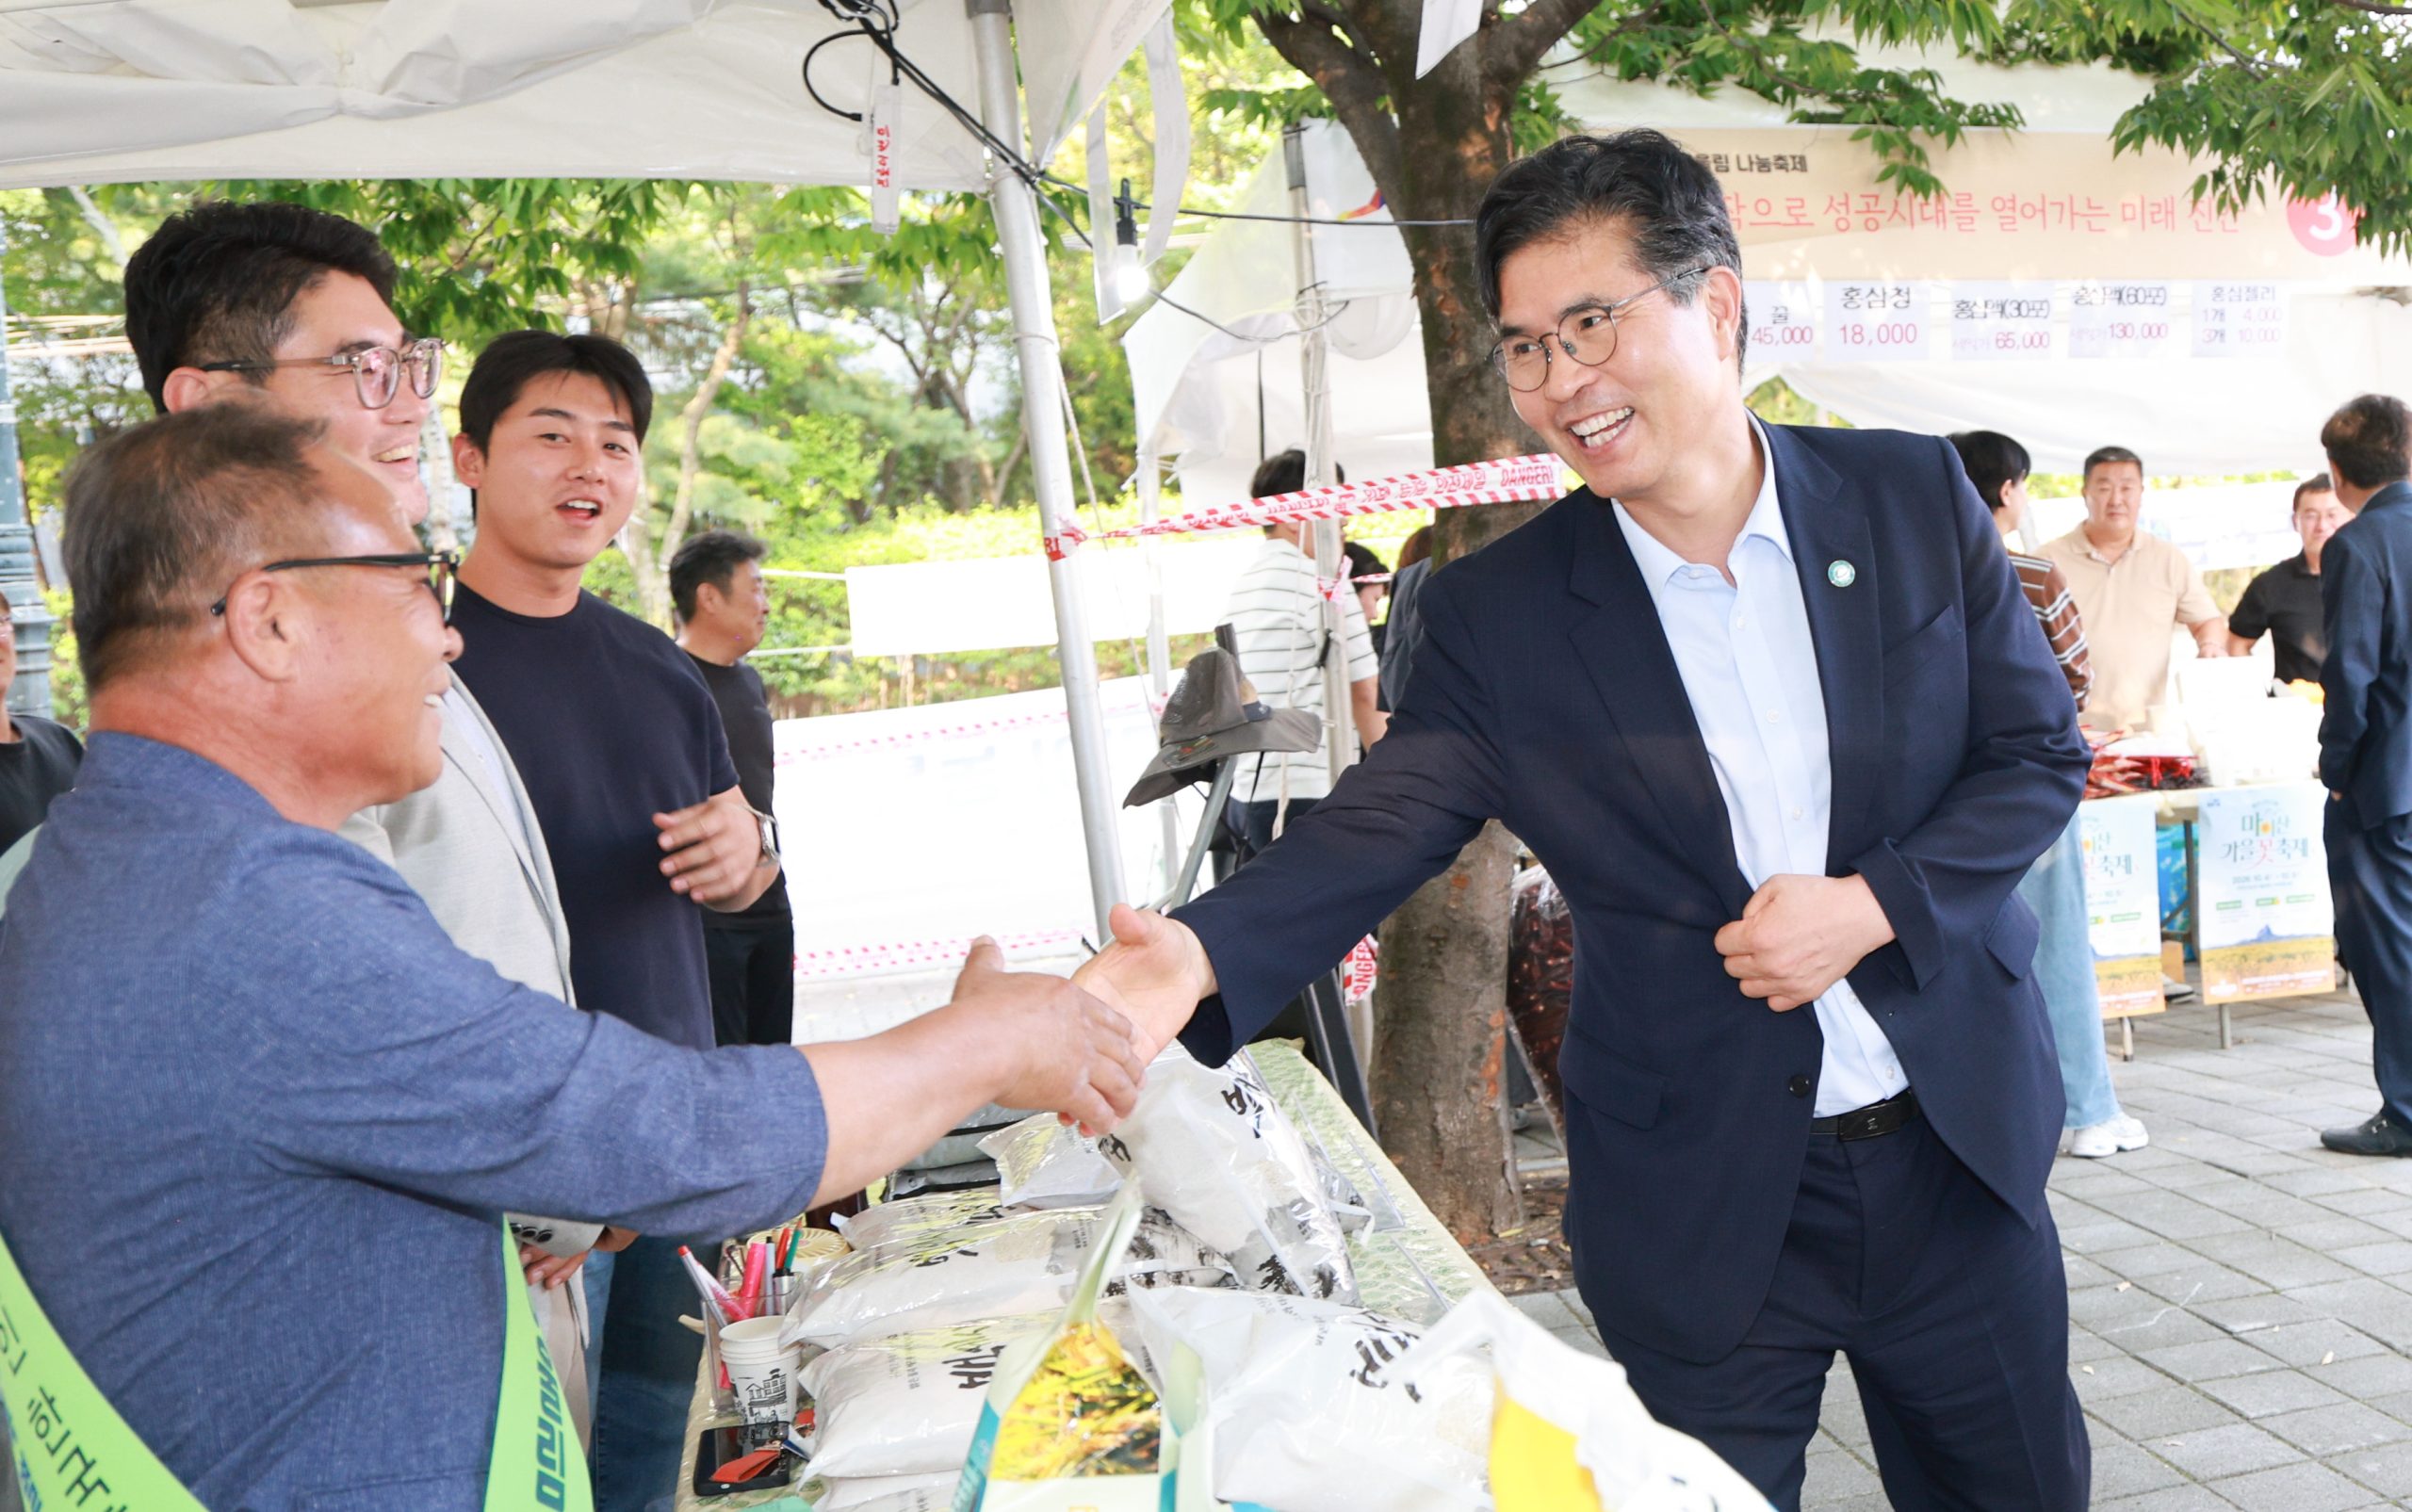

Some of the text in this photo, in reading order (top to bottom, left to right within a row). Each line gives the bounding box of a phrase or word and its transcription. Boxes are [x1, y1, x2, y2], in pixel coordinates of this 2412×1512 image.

[1736, 154, 1808, 173] 나눔축제
[1823, 191, 1980, 233] 성공시대를
[1990, 192, 2110, 233] 열어가는
[2121, 193, 2176, 232] 미래
[1752, 326, 1814, 347] 45,000
[1839, 323, 1918, 346] 18,000
[1995, 332, 2051, 350] 65,000
[2109, 322, 2169, 341] 130,000
[1499, 463, 1555, 488] DANGER!
